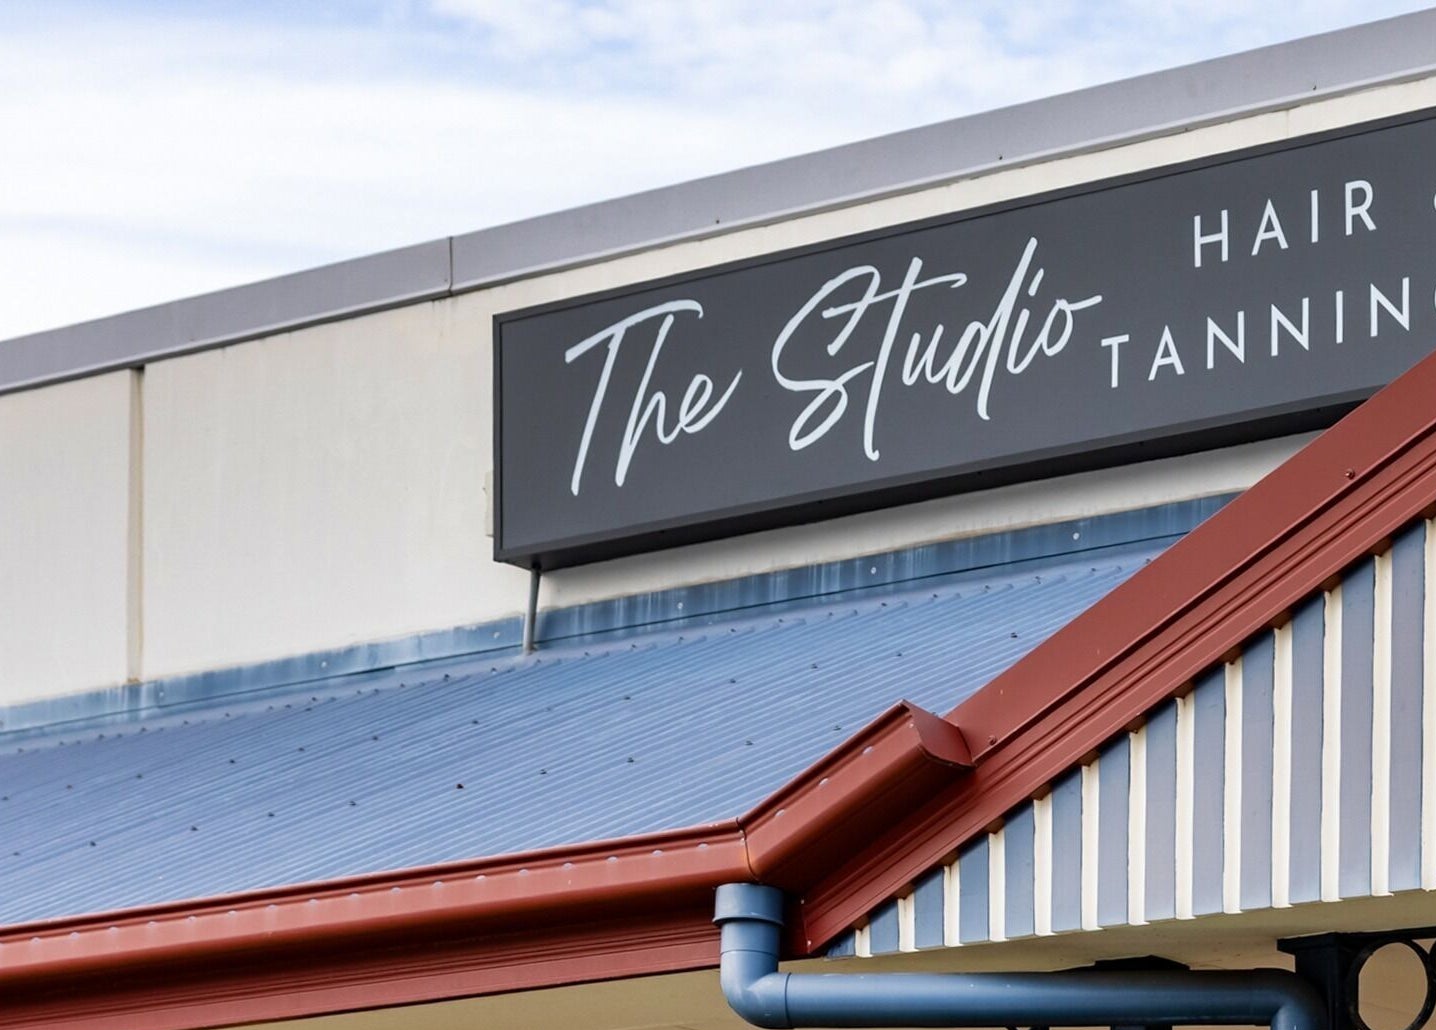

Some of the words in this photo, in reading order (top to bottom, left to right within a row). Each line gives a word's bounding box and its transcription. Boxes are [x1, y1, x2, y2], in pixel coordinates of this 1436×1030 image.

[1193, 180, 1377, 268] HAIR
[565, 298, 743, 496] The
[771, 235, 1103, 462] Studio
